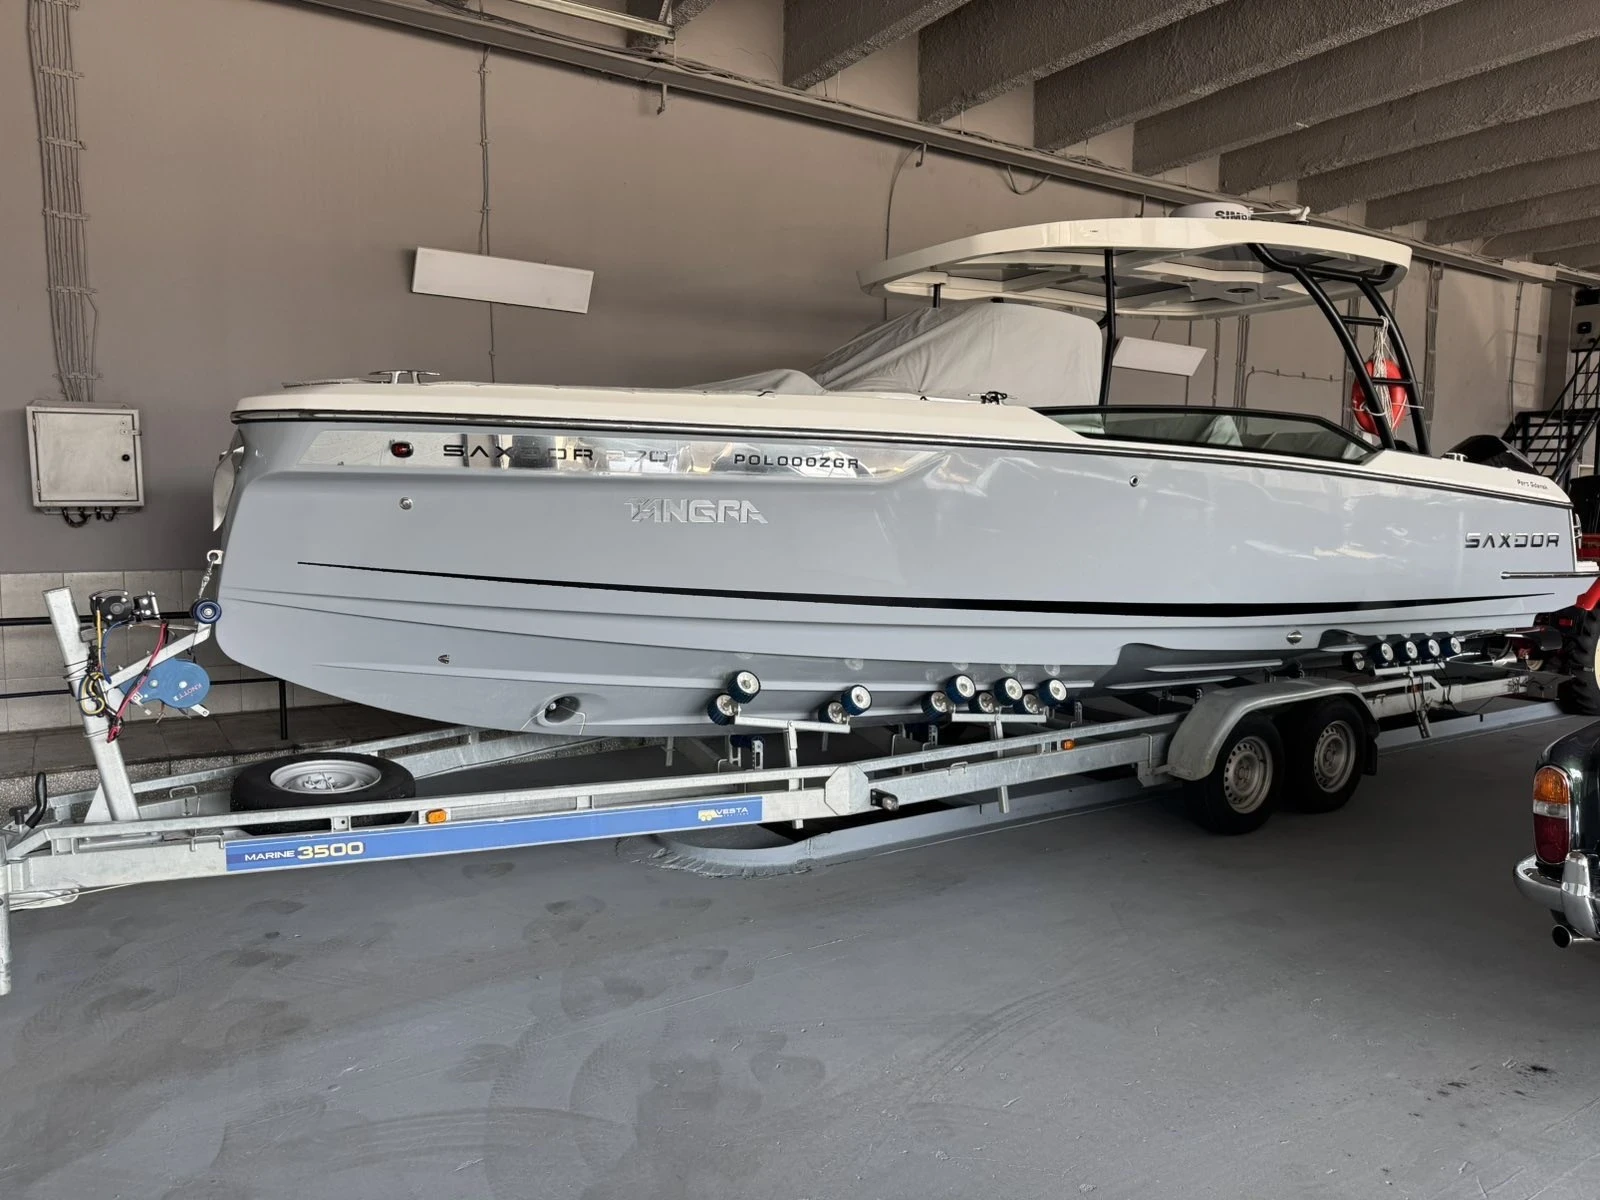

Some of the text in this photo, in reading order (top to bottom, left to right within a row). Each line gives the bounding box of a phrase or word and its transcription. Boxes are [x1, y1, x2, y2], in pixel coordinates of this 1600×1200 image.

[443, 444, 594, 461] SAXDOR
[624, 497, 769, 524] TANGRA
[1465, 532, 1560, 549] SAXDOR
[178, 682, 202, 700] KNOTT
[715, 806, 749, 815] VESTA
[244, 841, 365, 862] MARINE 3500
